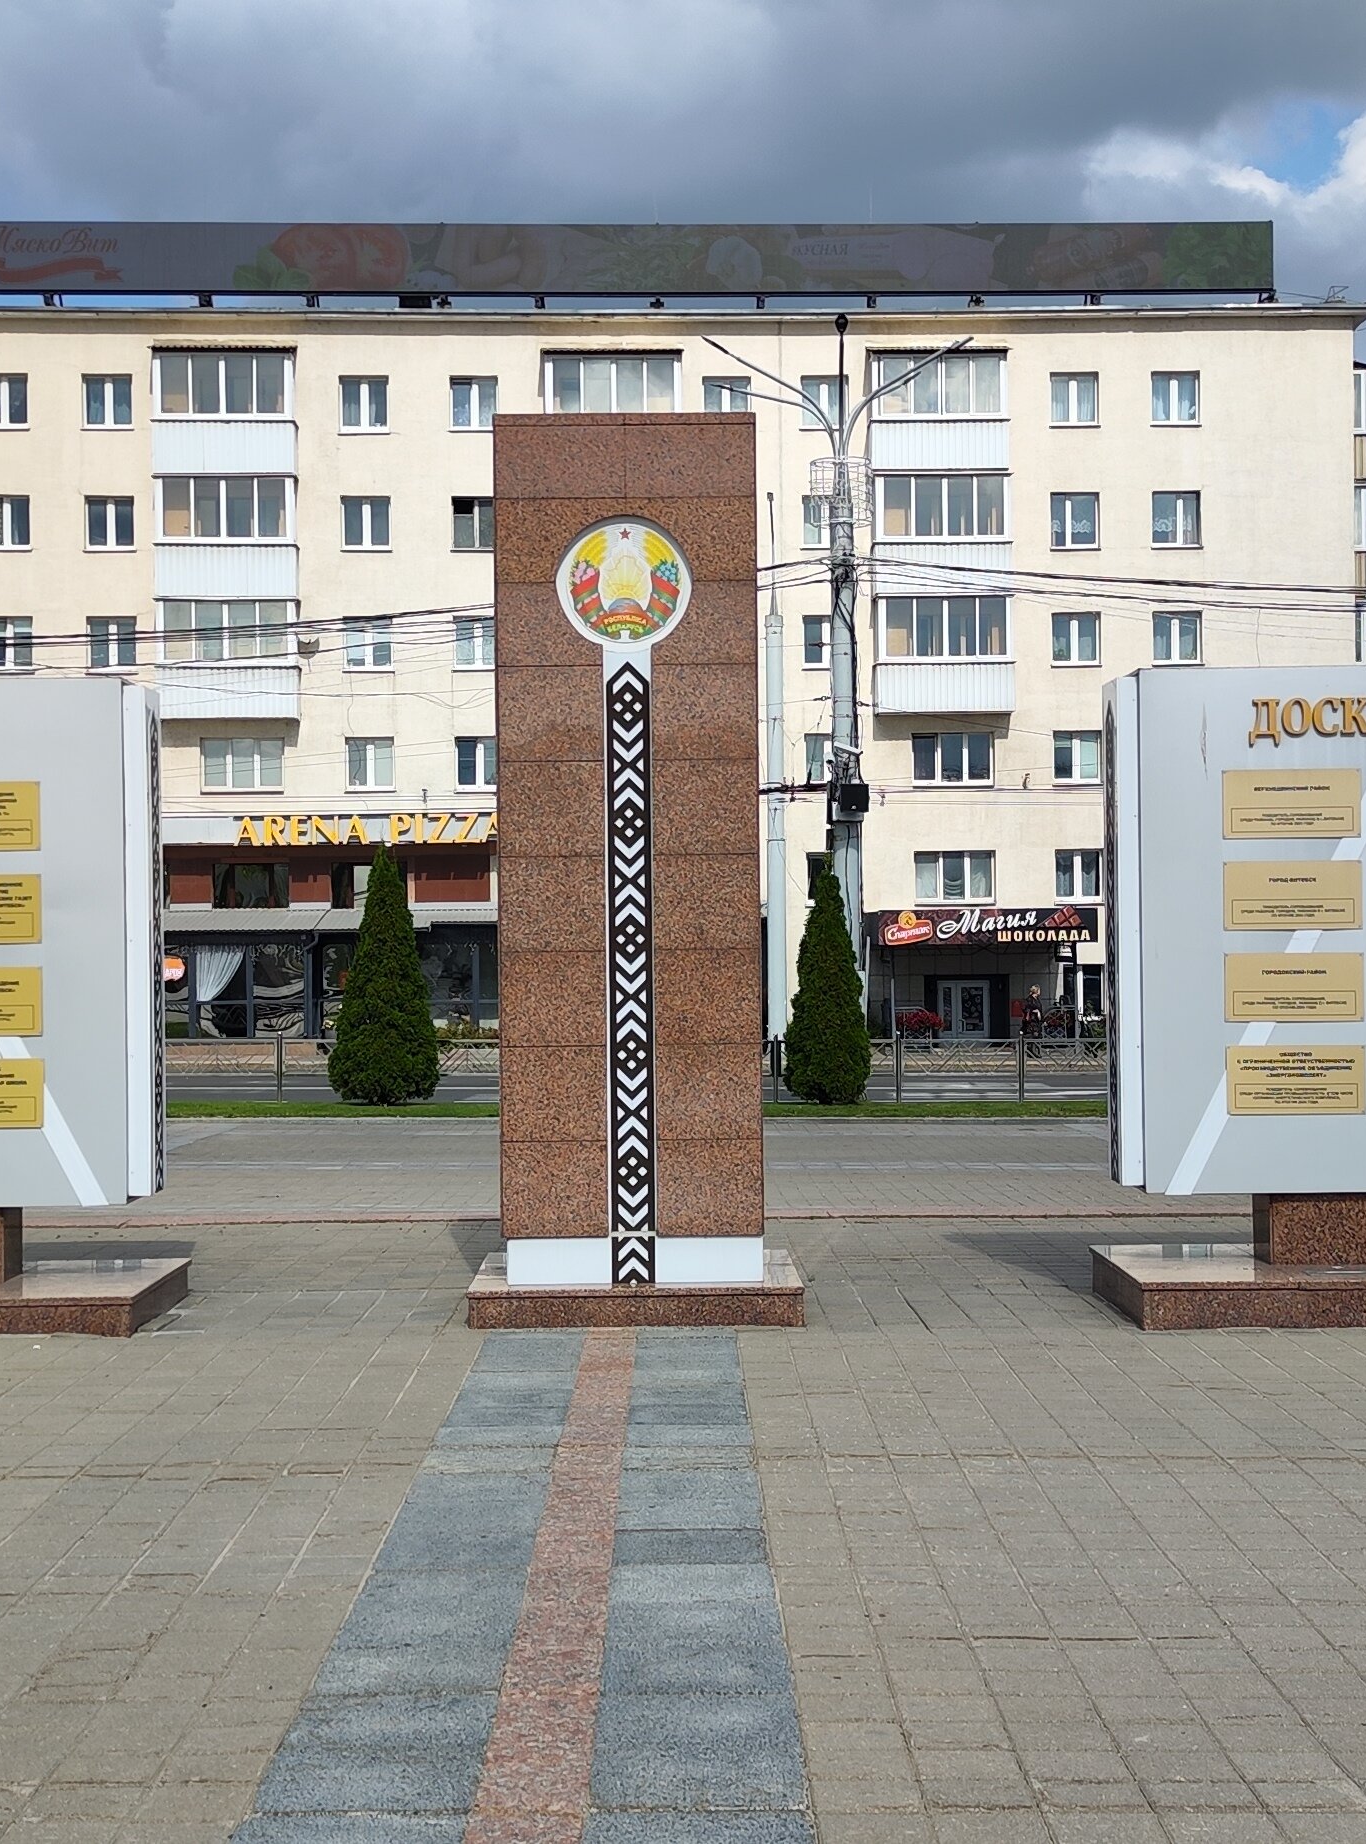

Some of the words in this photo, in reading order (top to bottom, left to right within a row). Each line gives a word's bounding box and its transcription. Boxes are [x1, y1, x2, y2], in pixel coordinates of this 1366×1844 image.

[234, 815, 370, 846] ARENA
[887, 926, 930, 940] Спартак
[937, 909, 1037, 939] Магия
[997, 929, 1091, 942] ШОКОЛАДА
